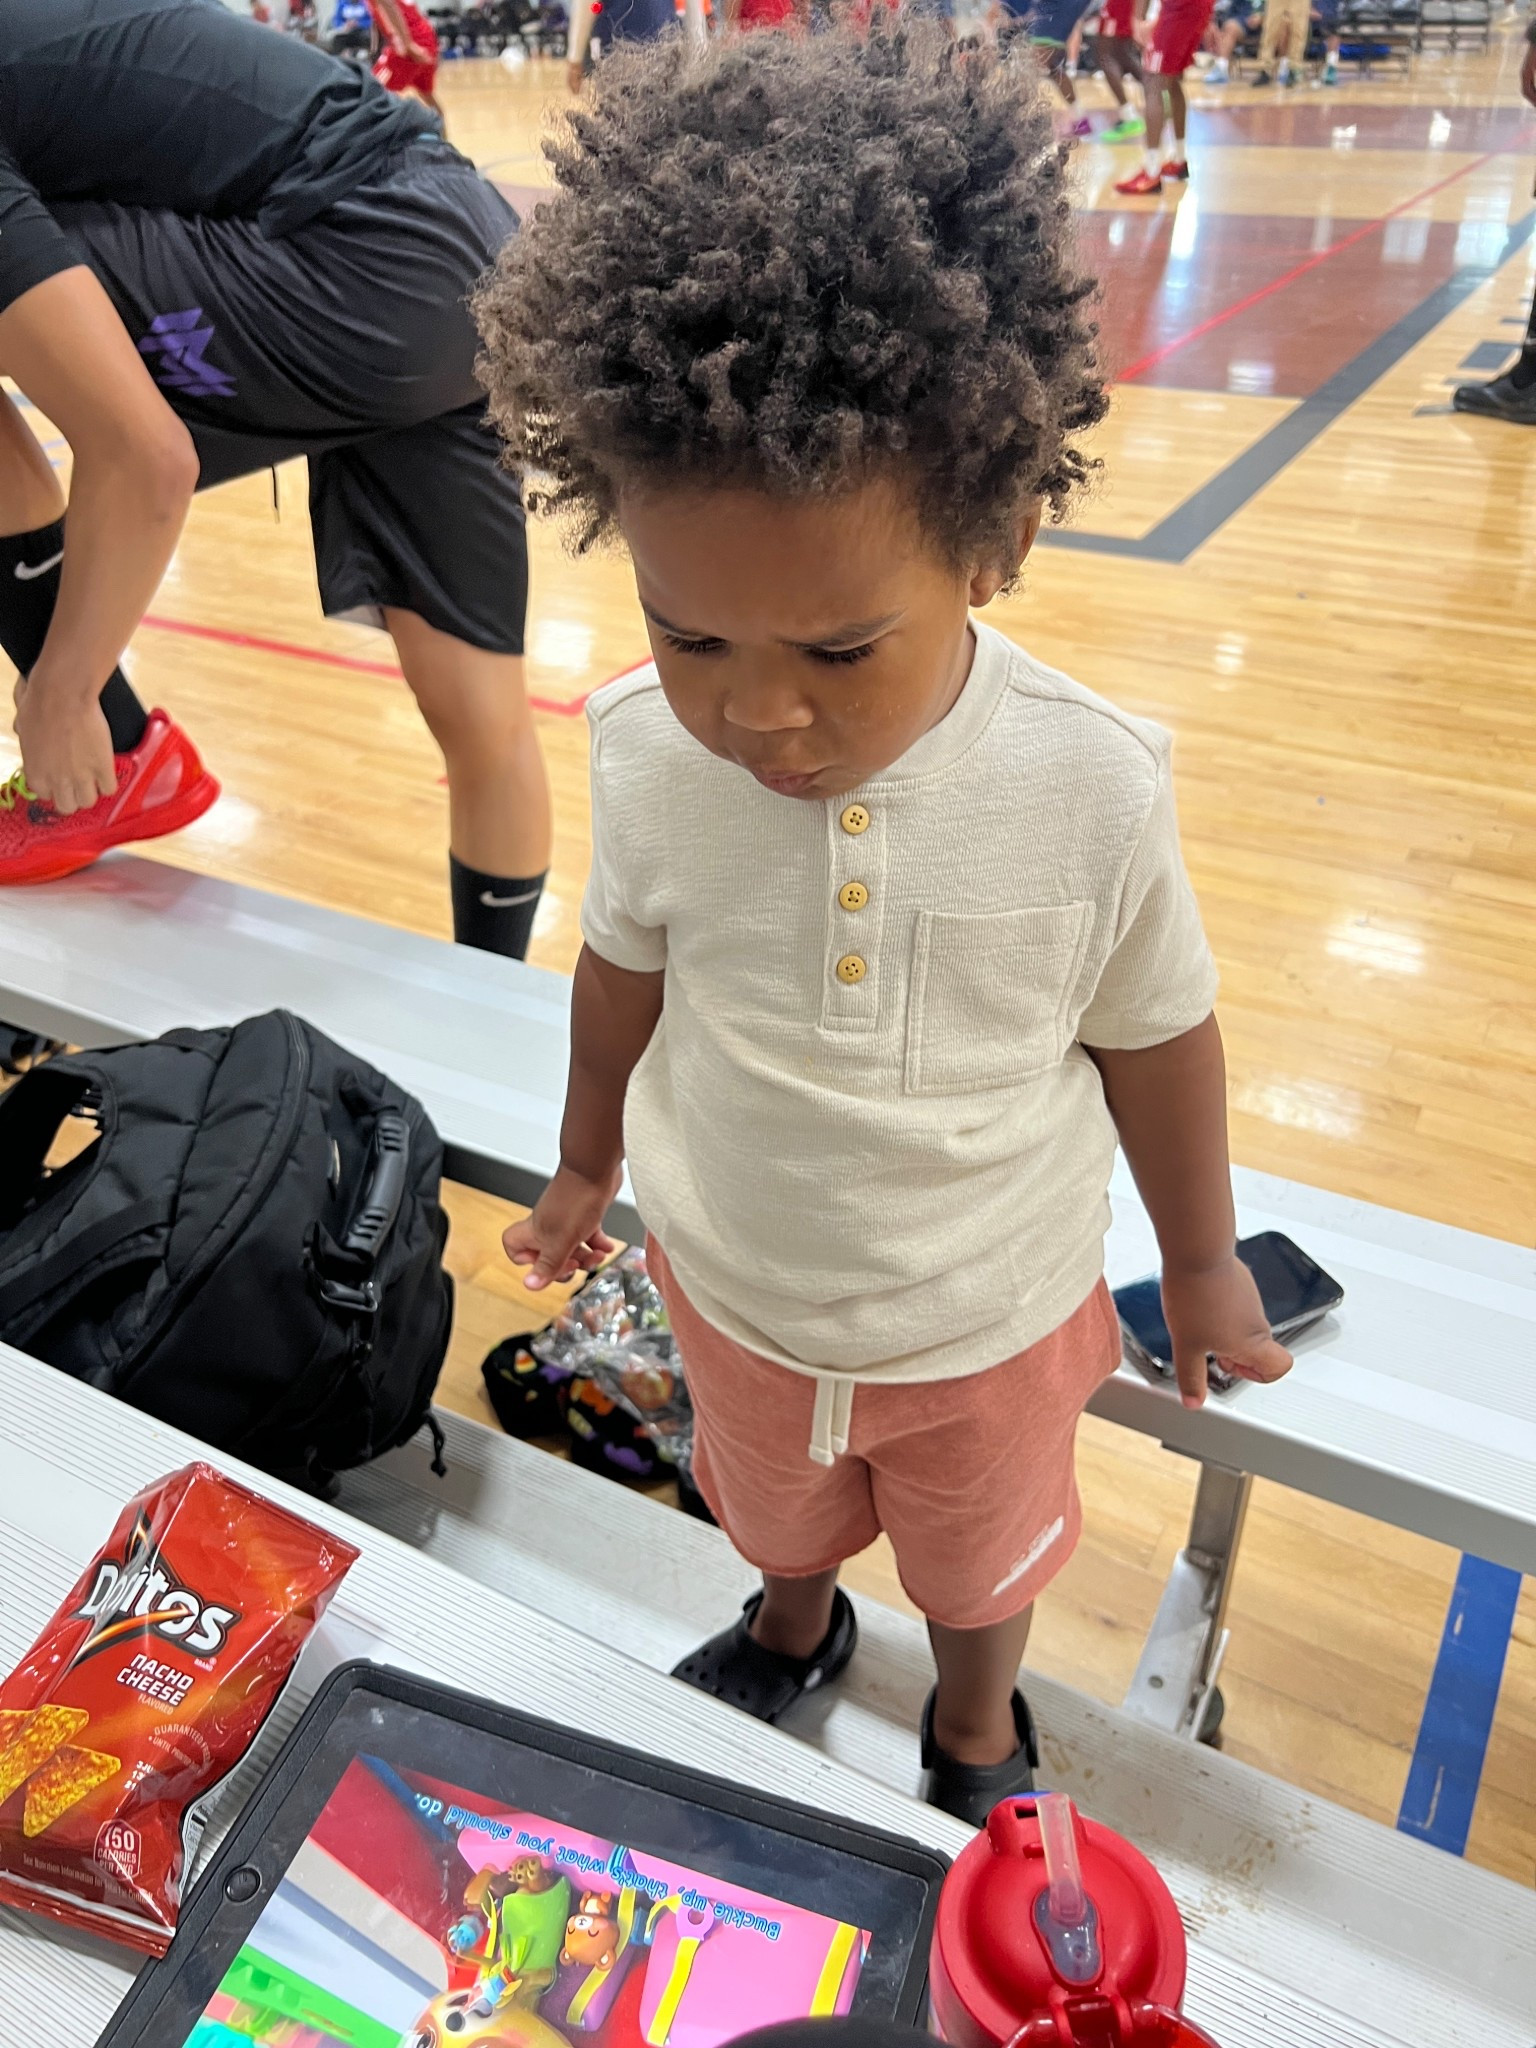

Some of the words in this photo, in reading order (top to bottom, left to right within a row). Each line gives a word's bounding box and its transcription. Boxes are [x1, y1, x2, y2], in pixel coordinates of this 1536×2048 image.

[77, 1563, 236, 1652] Doritos
[130, 1653, 194, 1690] NACHO
[116, 1667, 185, 1706] CHEESE
[137, 1693, 174, 1716] FLAVORED
[154, 1723, 204, 1745] GUARANTEED
[414, 1792, 444, 1818] do.
[443, 1804, 513, 1840] should
[104, 1826, 135, 1852] 150
[516, 1831, 556, 1855] you
[97, 1847, 137, 1864] CALORIES
[556, 1846, 607, 1874] what
[611, 1866, 669, 1900] that's
[677, 1886, 709, 1911] up,
[713, 1901, 783, 1941] Buckle
